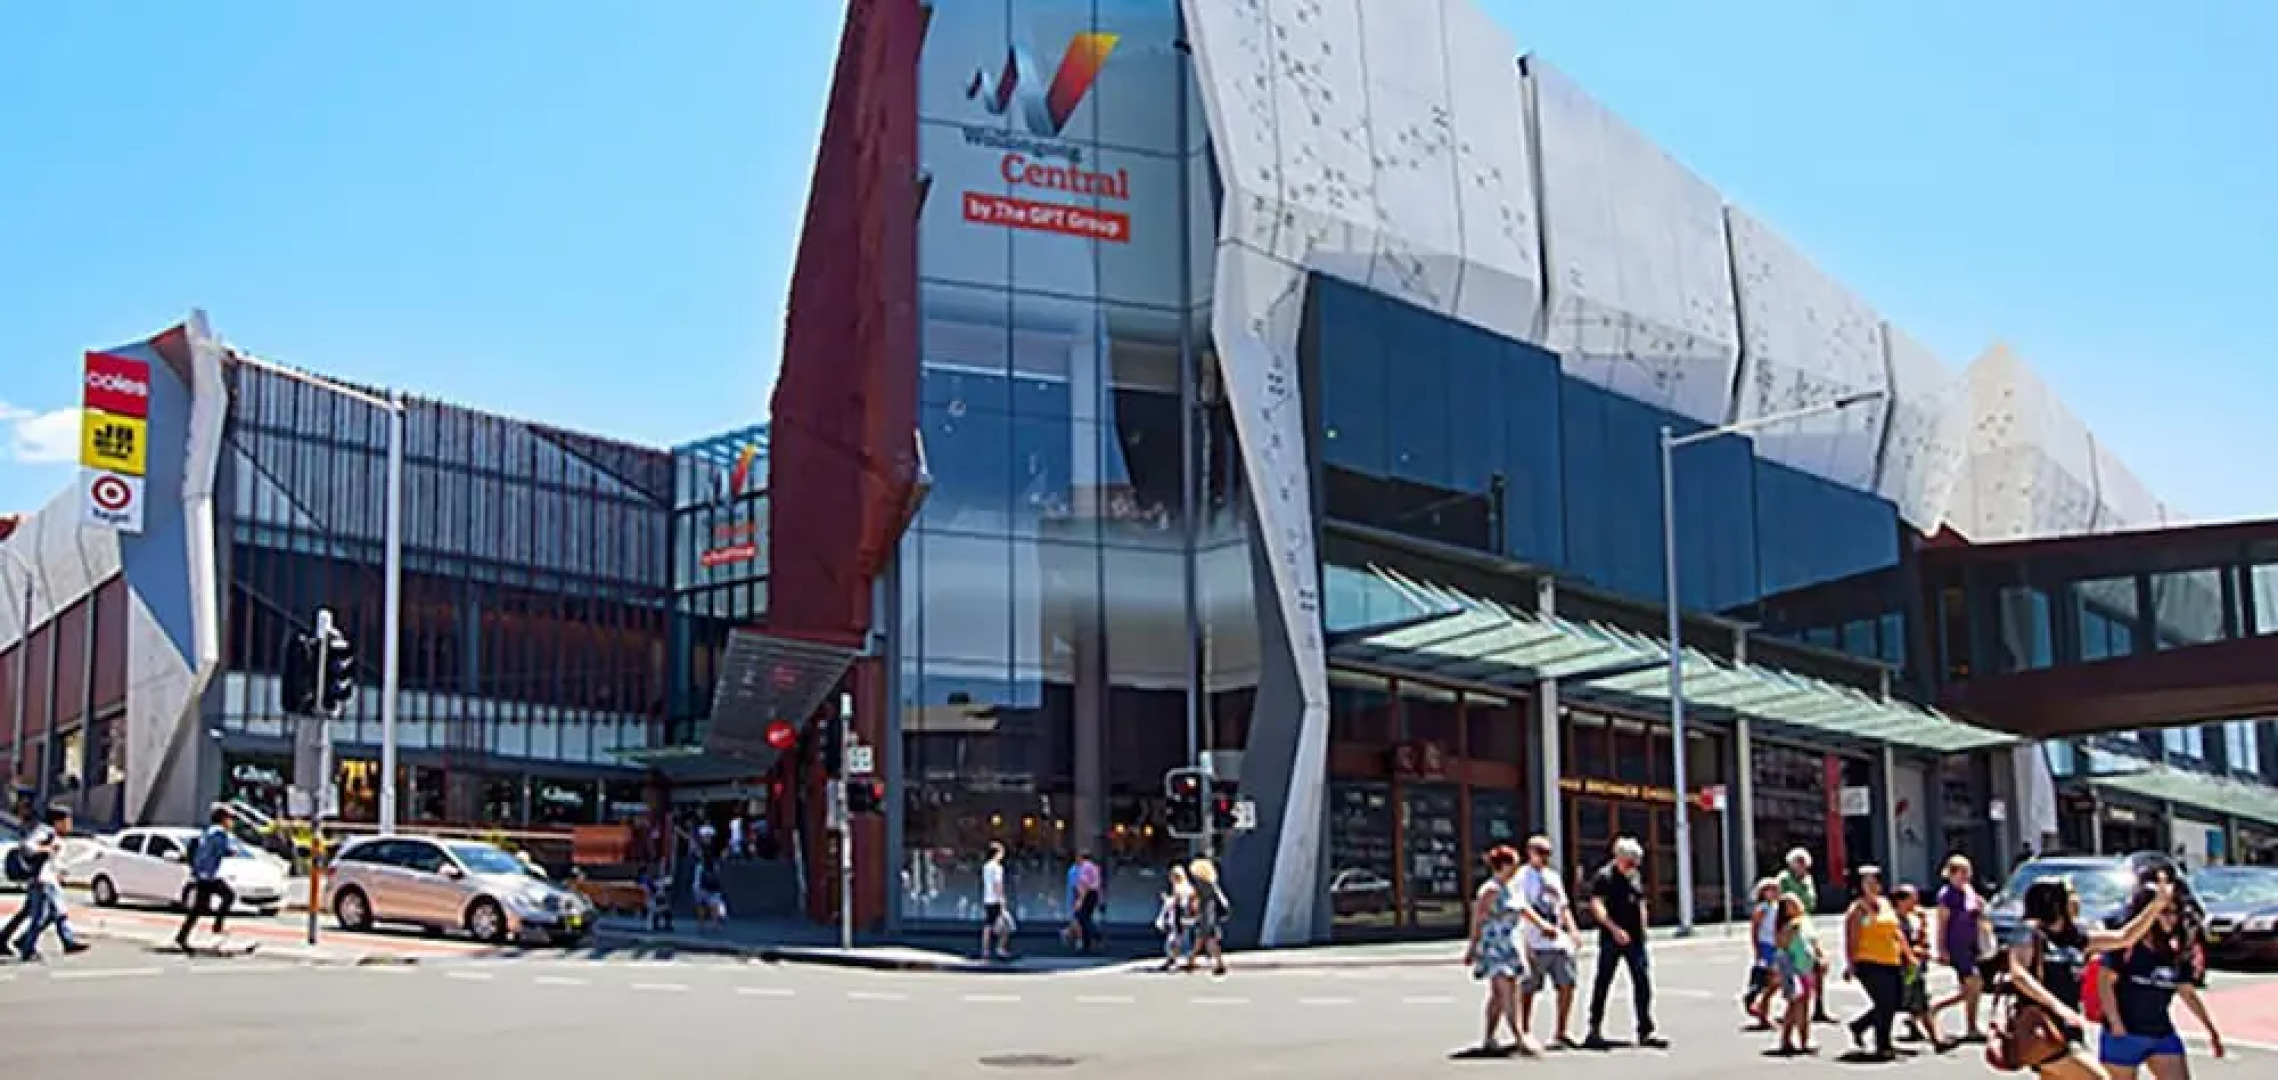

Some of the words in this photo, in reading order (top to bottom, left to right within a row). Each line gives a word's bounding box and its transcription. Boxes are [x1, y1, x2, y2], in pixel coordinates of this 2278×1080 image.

[1001, 153, 1129, 199] Central
[970, 199, 991, 219] by
[994, 201, 1026, 223] The
[85, 372, 148, 395] coles
